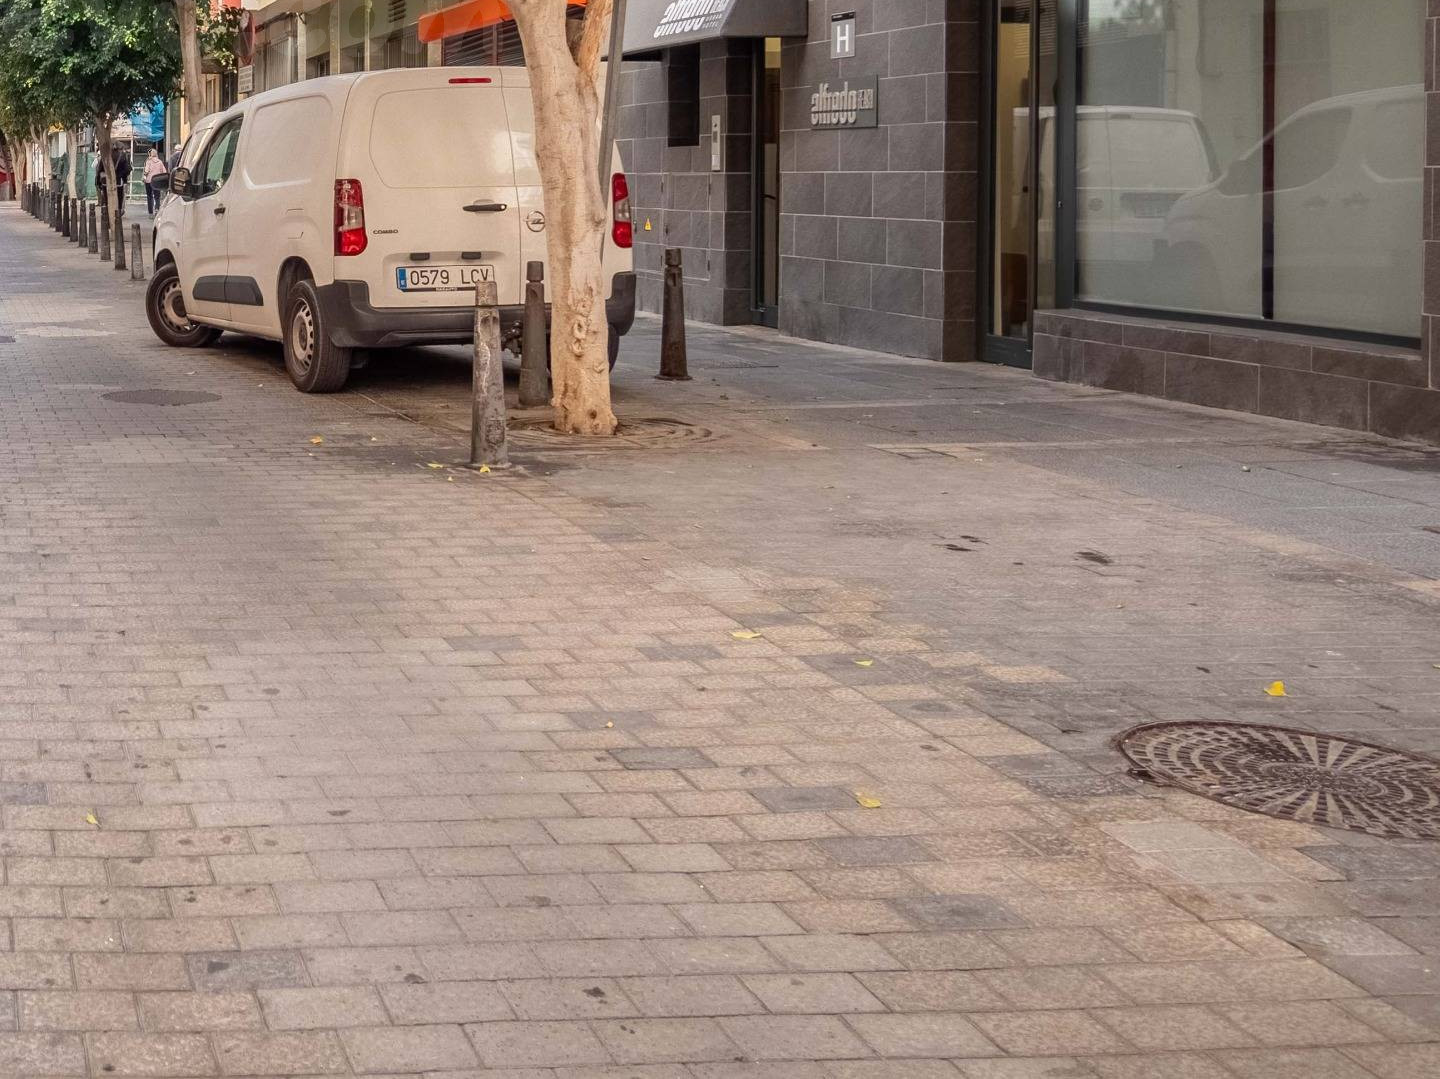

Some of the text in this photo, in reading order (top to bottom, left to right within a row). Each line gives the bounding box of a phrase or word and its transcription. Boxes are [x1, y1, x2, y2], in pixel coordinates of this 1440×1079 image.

[836, 24, 849, 53] H
[410, 268, 489, 286] 0579 LCV
